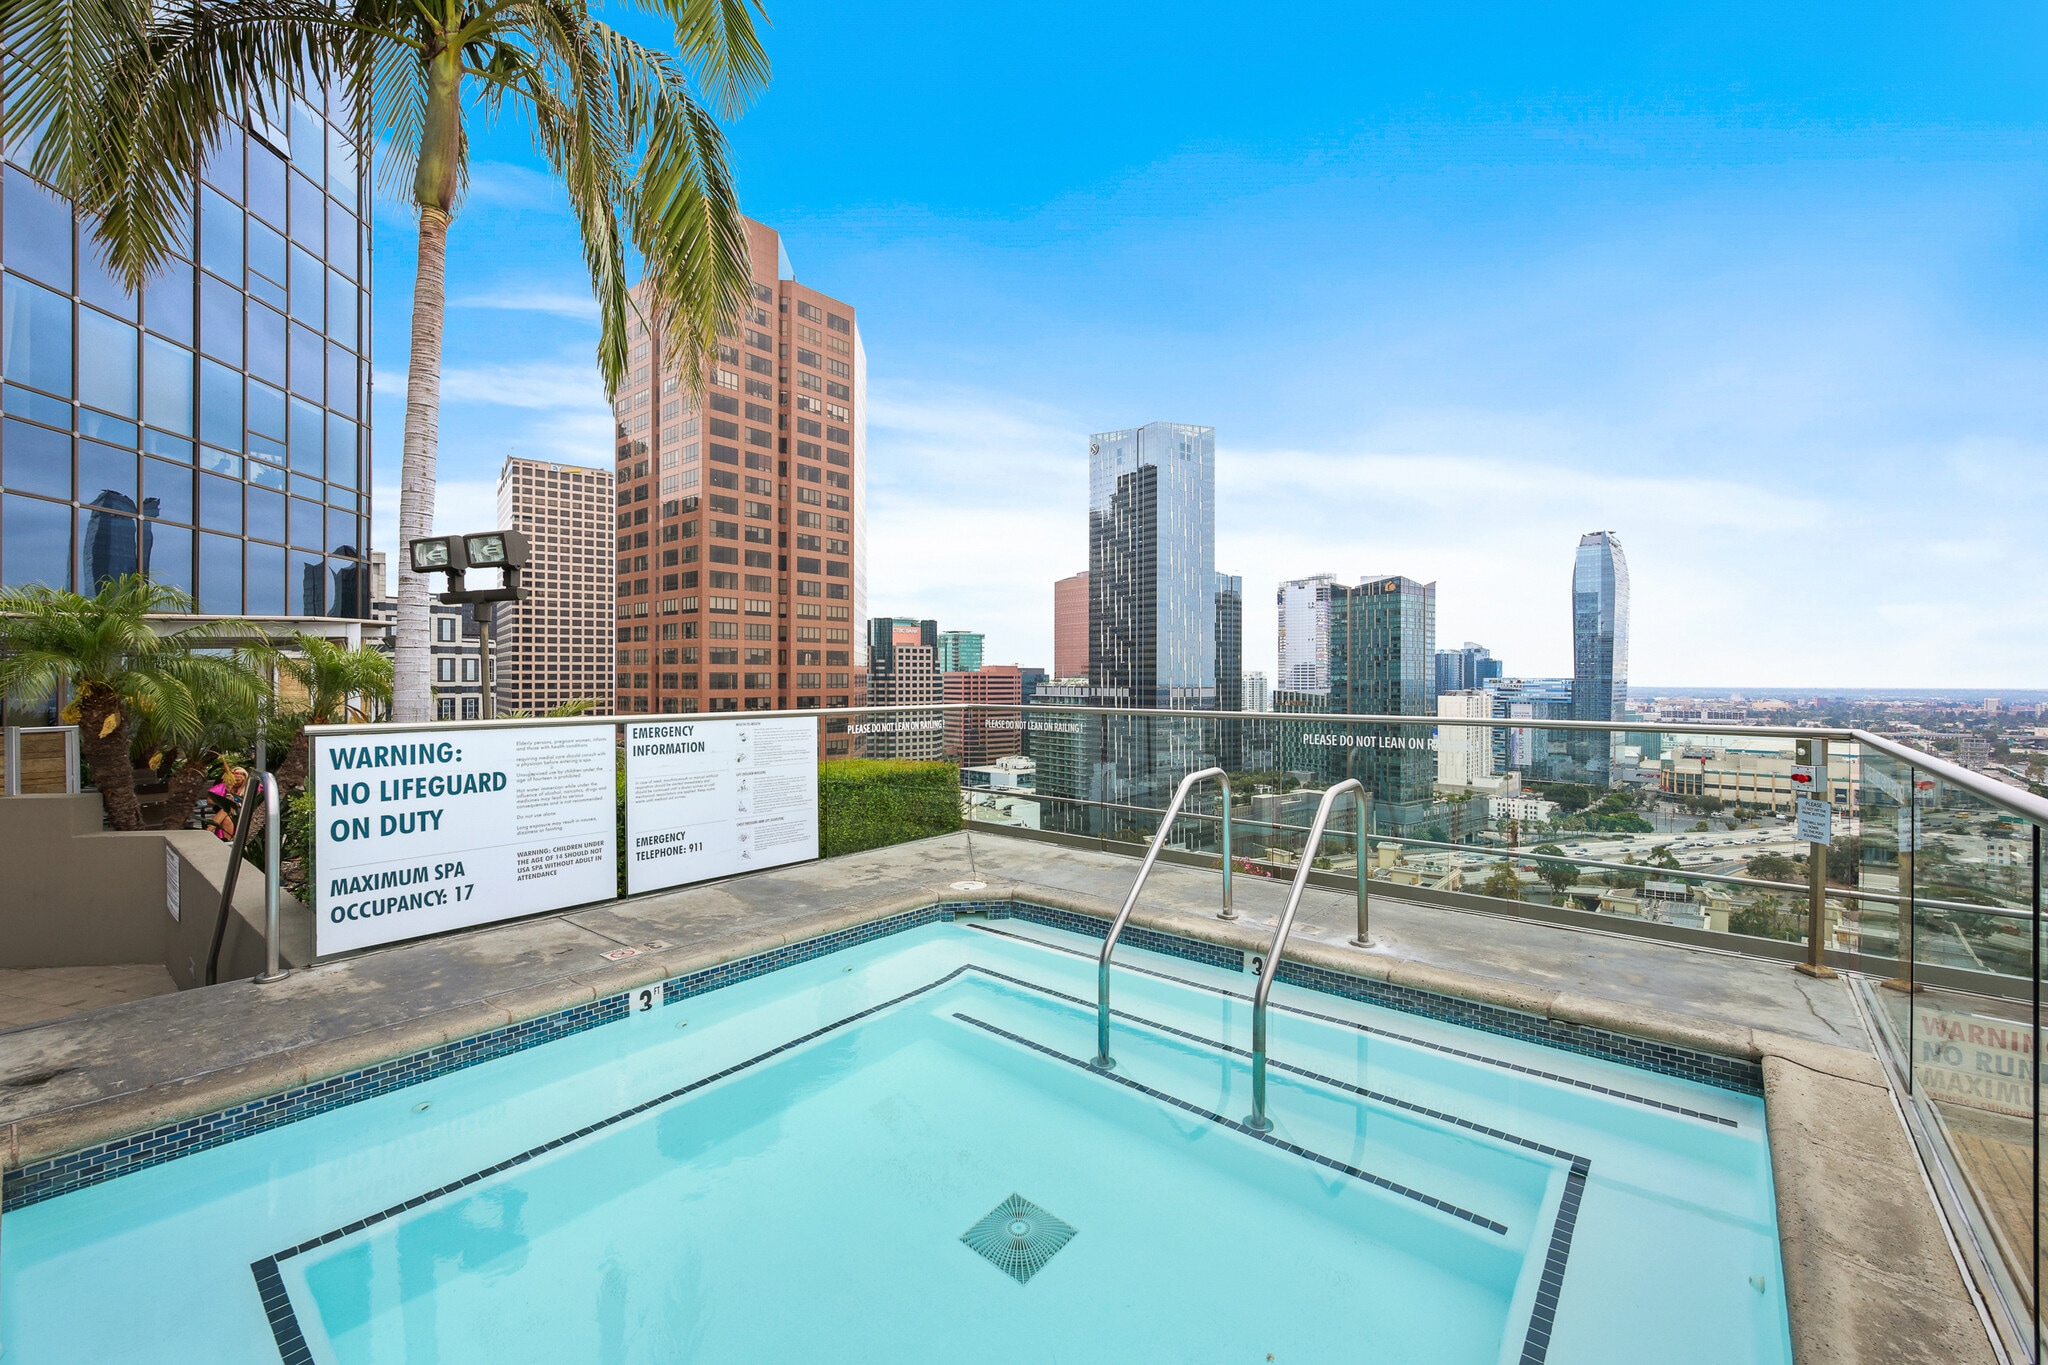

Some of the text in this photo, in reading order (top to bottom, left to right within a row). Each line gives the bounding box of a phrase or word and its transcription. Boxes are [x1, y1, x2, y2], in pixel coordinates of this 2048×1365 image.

[633, 725, 694, 739] EMERGENCY
[848, 724, 870, 734] PLEASE
[872, 724, 880, 732] DO
[882, 723, 895, 732] NOT
[895, 722, 909, 731] LEAN
[911, 721, 919, 730] ON
[985, 720, 1006, 729] PLEASE
[1006, 720, 1014, 729] DO
[1015, 721, 1026, 729] NOT
[1028, 721, 1042, 730] LEAN
[1044, 723, 1053, 731] ON
[633, 742, 705, 756] INFORMATION
[1303, 733, 1337, 746] PLEASE
[1340, 735, 1353, 746] DO
[1356, 736, 1376, 747] NOT
[1379, 737, 1405, 749] LEAN
[1408, 738, 1424, 749] ON
[329, 742, 462, 770] WARNING:
[330, 771, 507, 806] NO LIFEGUARD
[330, 809, 444, 842] ON DUTY
[636, 831, 686, 847] EMERGENCY
[517, 849, 551, 857] WARNING:
[553, 844, 582, 853] CHILDREN
[636, 842, 702, 861] TELEPHONE: 911
[518, 857, 529, 866] THE
[532, 863, 543, 871] SPA
[545, 860, 573, 869] WITHOUT
[330, 861, 465, 897] MAXIMUM SPA
[517, 870, 557, 881] ATTENDANCE
[330, 884, 474, 924] OCCUPANCY: 17
[1252, 957, 1262, 976] 3
[640, 986, 660, 1012] 3 FT
[1923, 1041, 1963, 1066] NO
